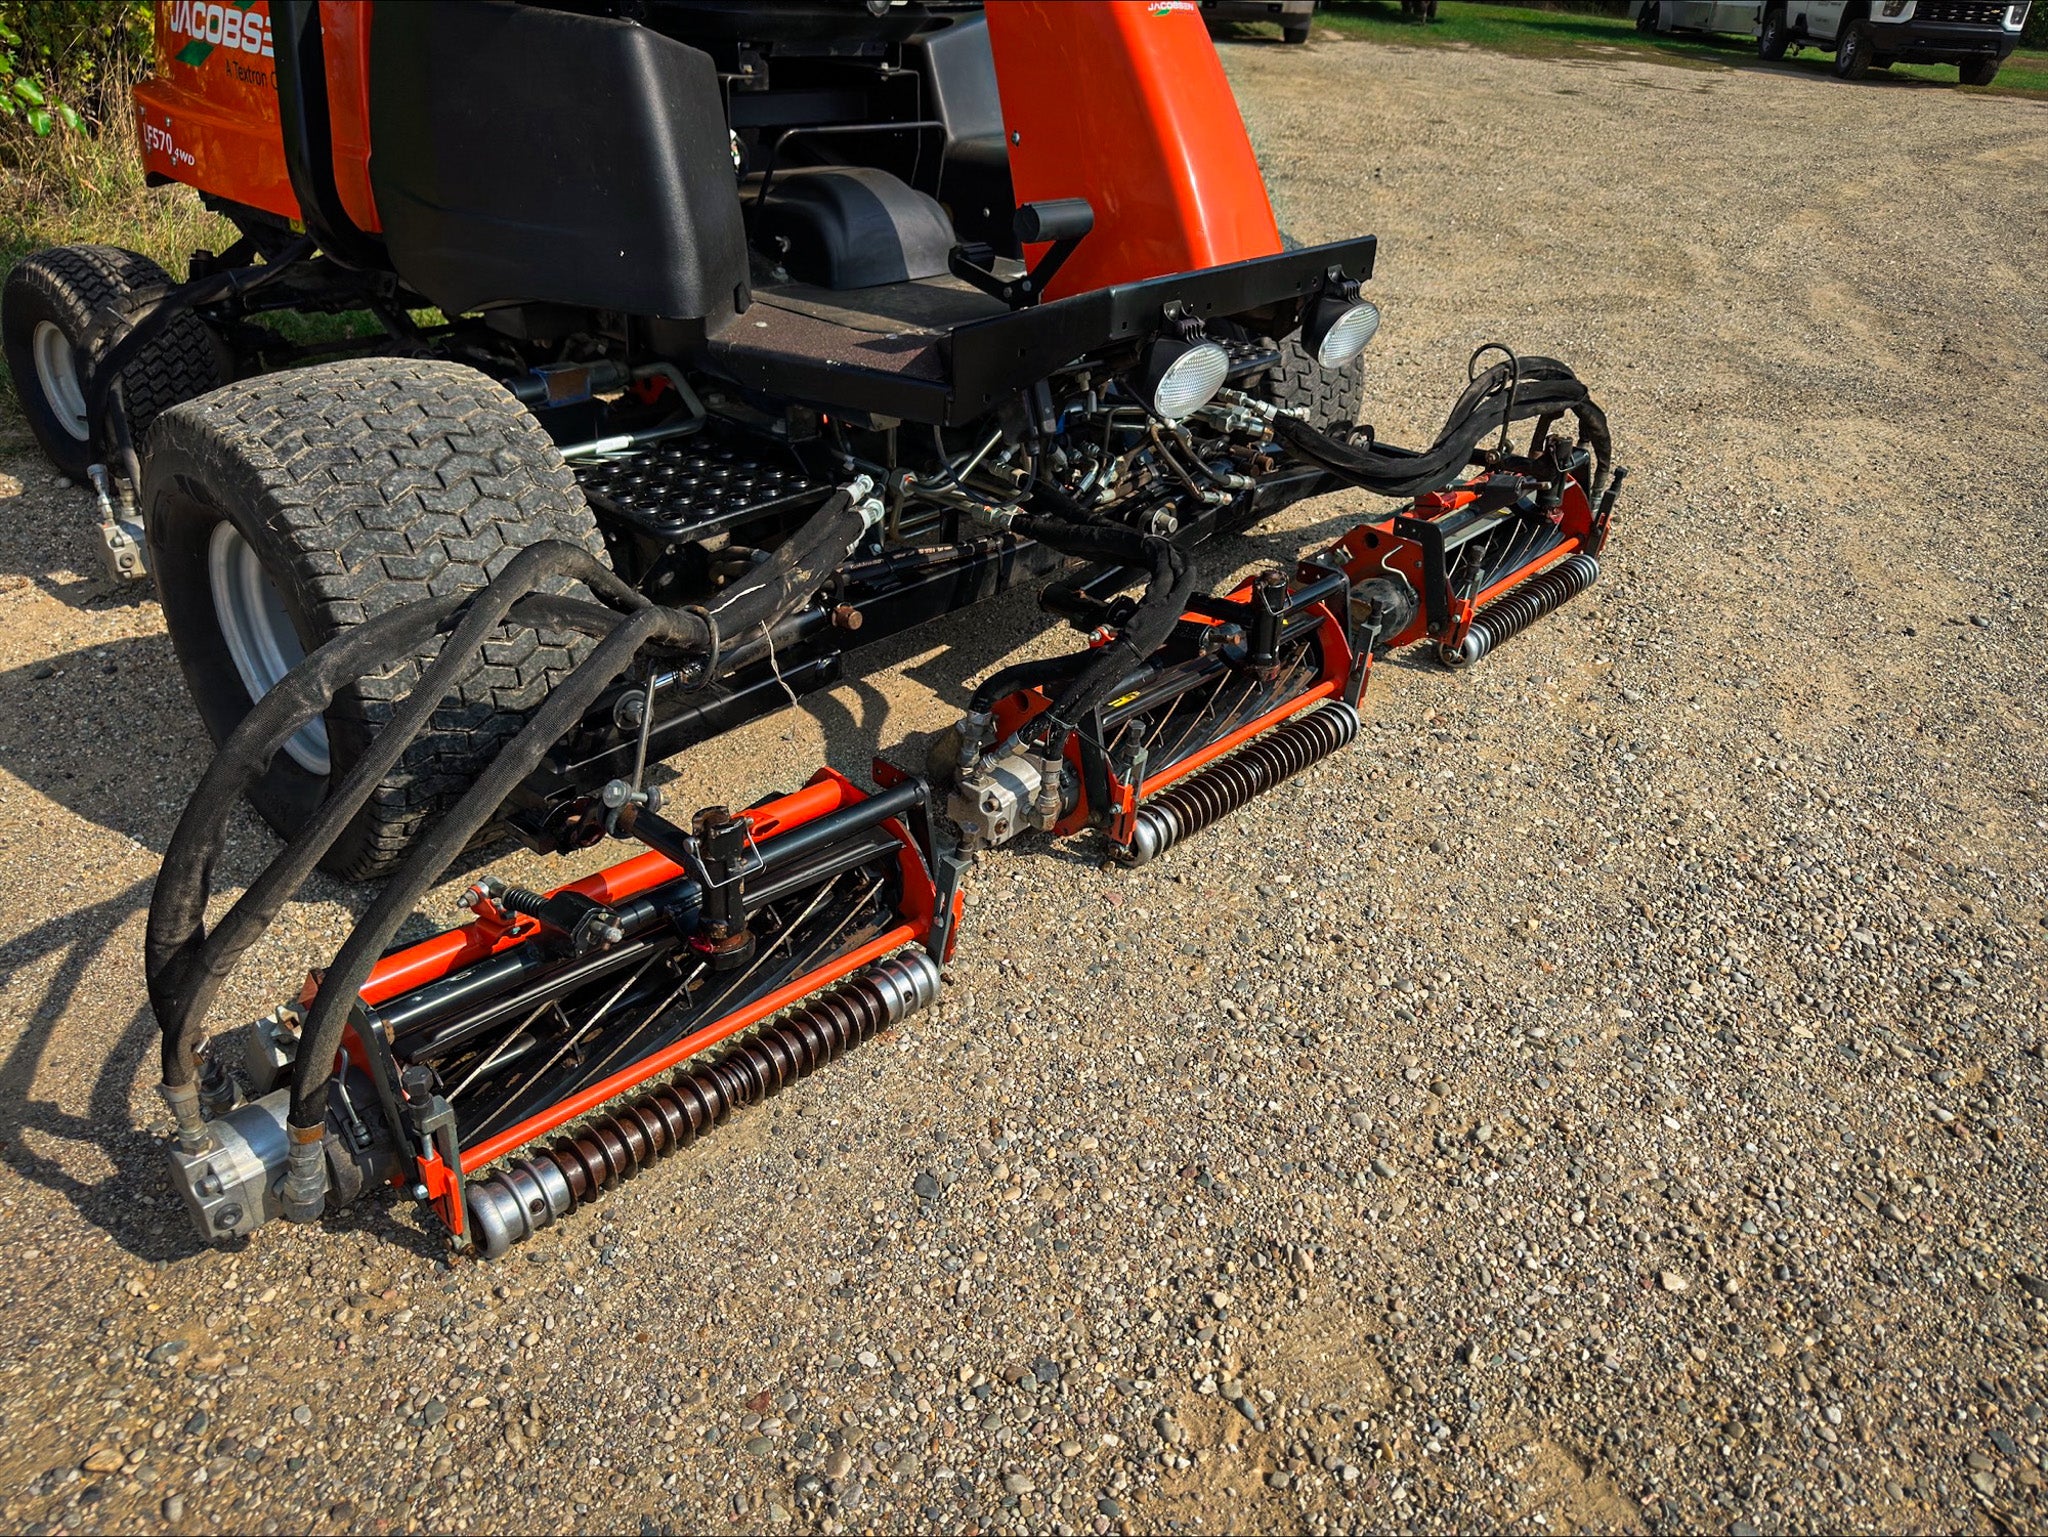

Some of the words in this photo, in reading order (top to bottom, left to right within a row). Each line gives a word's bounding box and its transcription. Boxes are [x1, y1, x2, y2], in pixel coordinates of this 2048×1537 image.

[1148, 1, 1194, 11] JACOBSEN
[225, 59, 232, 77] A
[233, 61, 266, 86] Textron
[143, 122, 172, 155] LF570
[174, 147, 195, 166] 4WD
